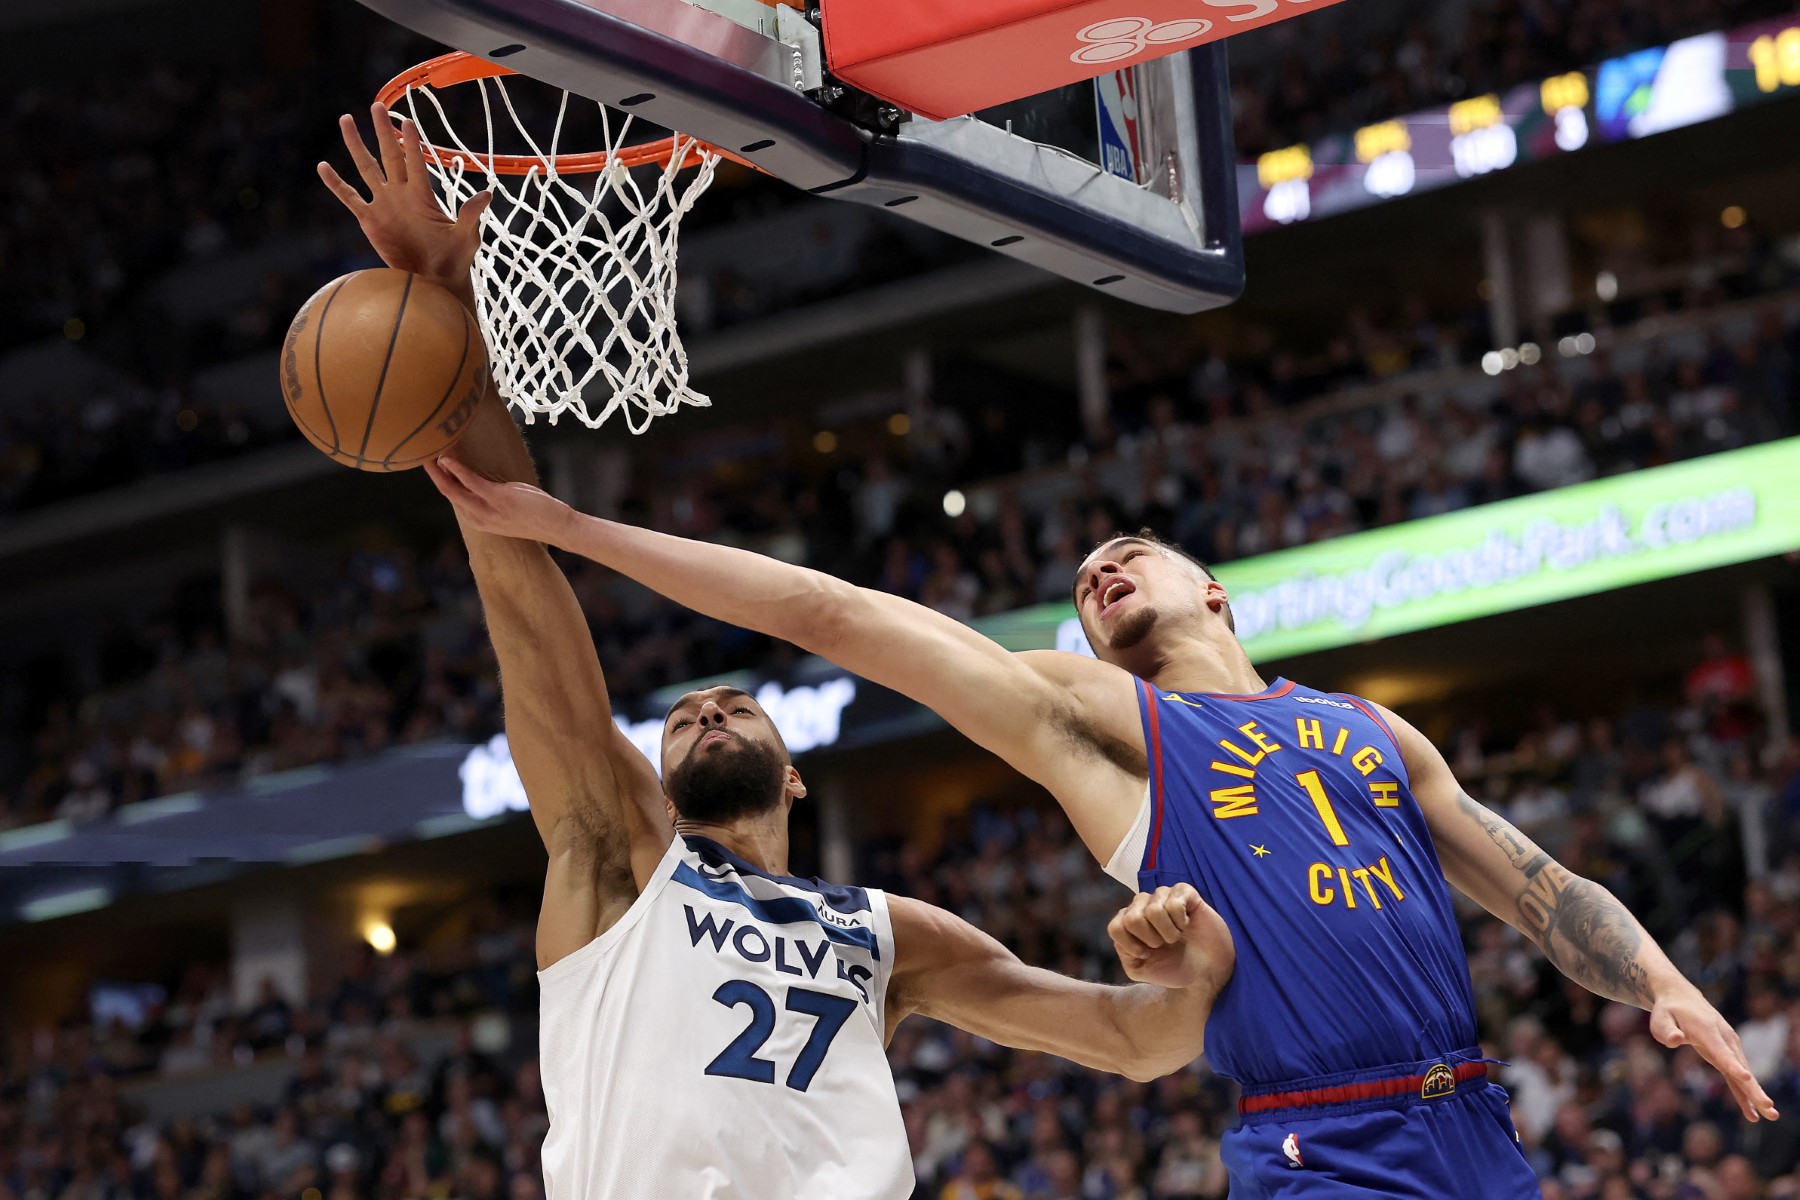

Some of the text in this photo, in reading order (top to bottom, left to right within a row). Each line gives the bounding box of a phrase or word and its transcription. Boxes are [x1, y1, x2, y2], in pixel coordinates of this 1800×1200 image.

[1209, 717, 1401, 820] MILE HIGH
[1294, 768, 1351, 847] 1
[1307, 854, 1406, 911] CITY
[703, 979, 859, 1093] 27
